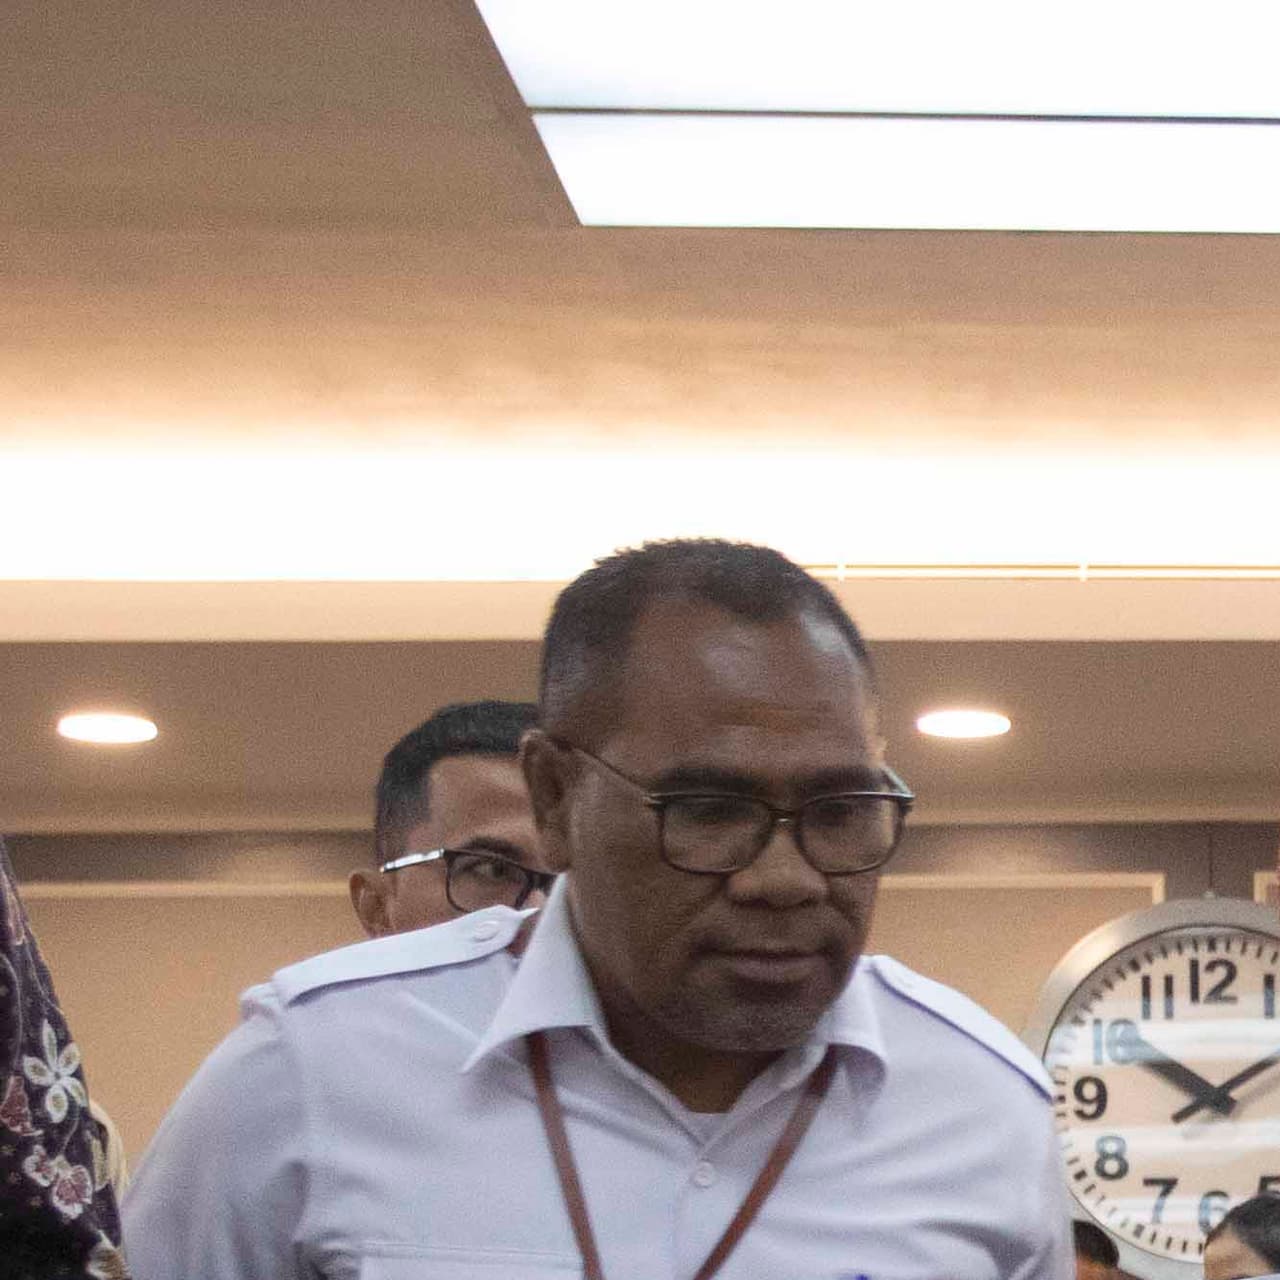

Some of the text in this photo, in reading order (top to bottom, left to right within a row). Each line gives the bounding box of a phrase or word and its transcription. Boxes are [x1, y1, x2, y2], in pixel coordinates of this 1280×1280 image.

[1141, 974, 1174, 1020] 11
[1189, 959, 1238, 1005] 12
[1263, 973, 1276, 1019] 1
[1092, 1018, 1141, 1066] 10
[1073, 1076, 1108, 1121] 9
[1094, 1135, 1129, 1180] 8
[1143, 1177, 1178, 1225] 7
